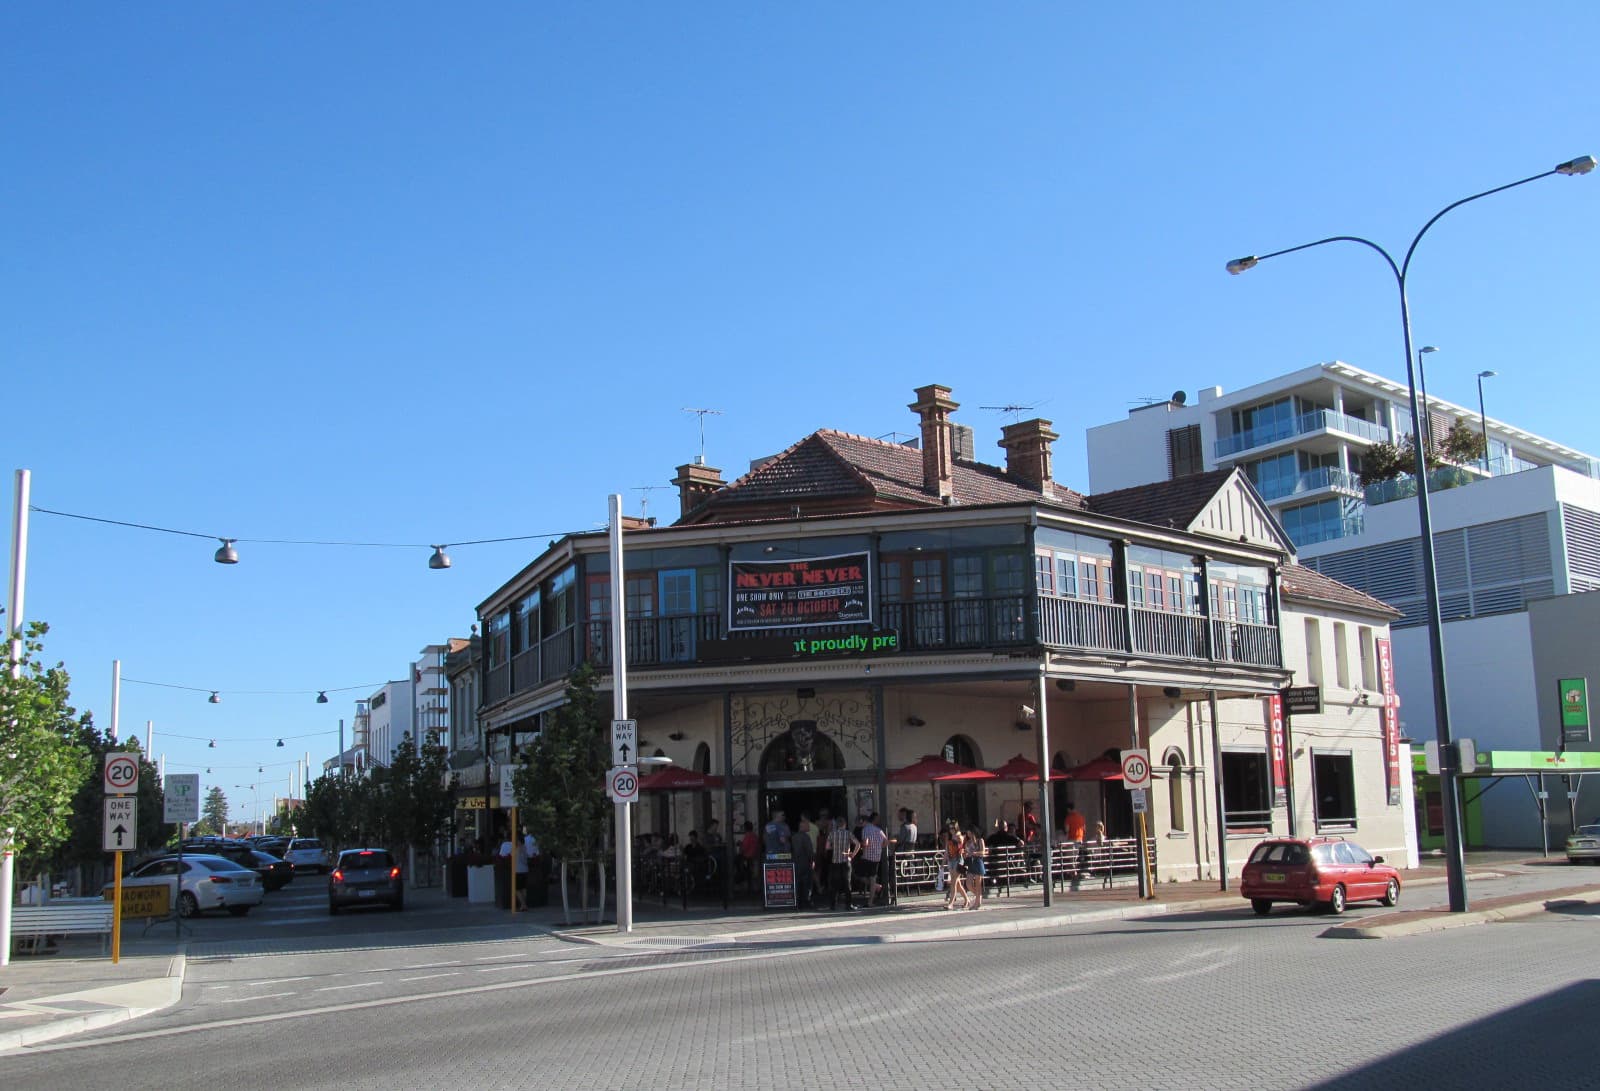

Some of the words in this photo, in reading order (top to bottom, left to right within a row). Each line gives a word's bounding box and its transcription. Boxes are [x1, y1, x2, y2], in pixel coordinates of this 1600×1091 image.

[790, 563, 808, 571] THE
[737, 572, 795, 586] NEVER
[803, 567, 862, 583] NEVER
[736, 592, 749, 602] ONE
[750, 592, 767, 601] SHOW
[769, 591, 784, 601] ONLY
[760, 603, 777, 617] SAT
[781, 602, 794, 616] 20
[797, 598, 840, 615] OCTOBER
[811, 635, 868, 654] proudly
[872, 635, 896, 651] pre
[1274, 705, 1283, 760] FOOD
[111, 765, 134, 780] 20
[1128, 763, 1143, 775] 40
[618, 779, 634, 790] 20
[110, 801, 131, 810] ONE
[109, 812, 131, 821] WAY
